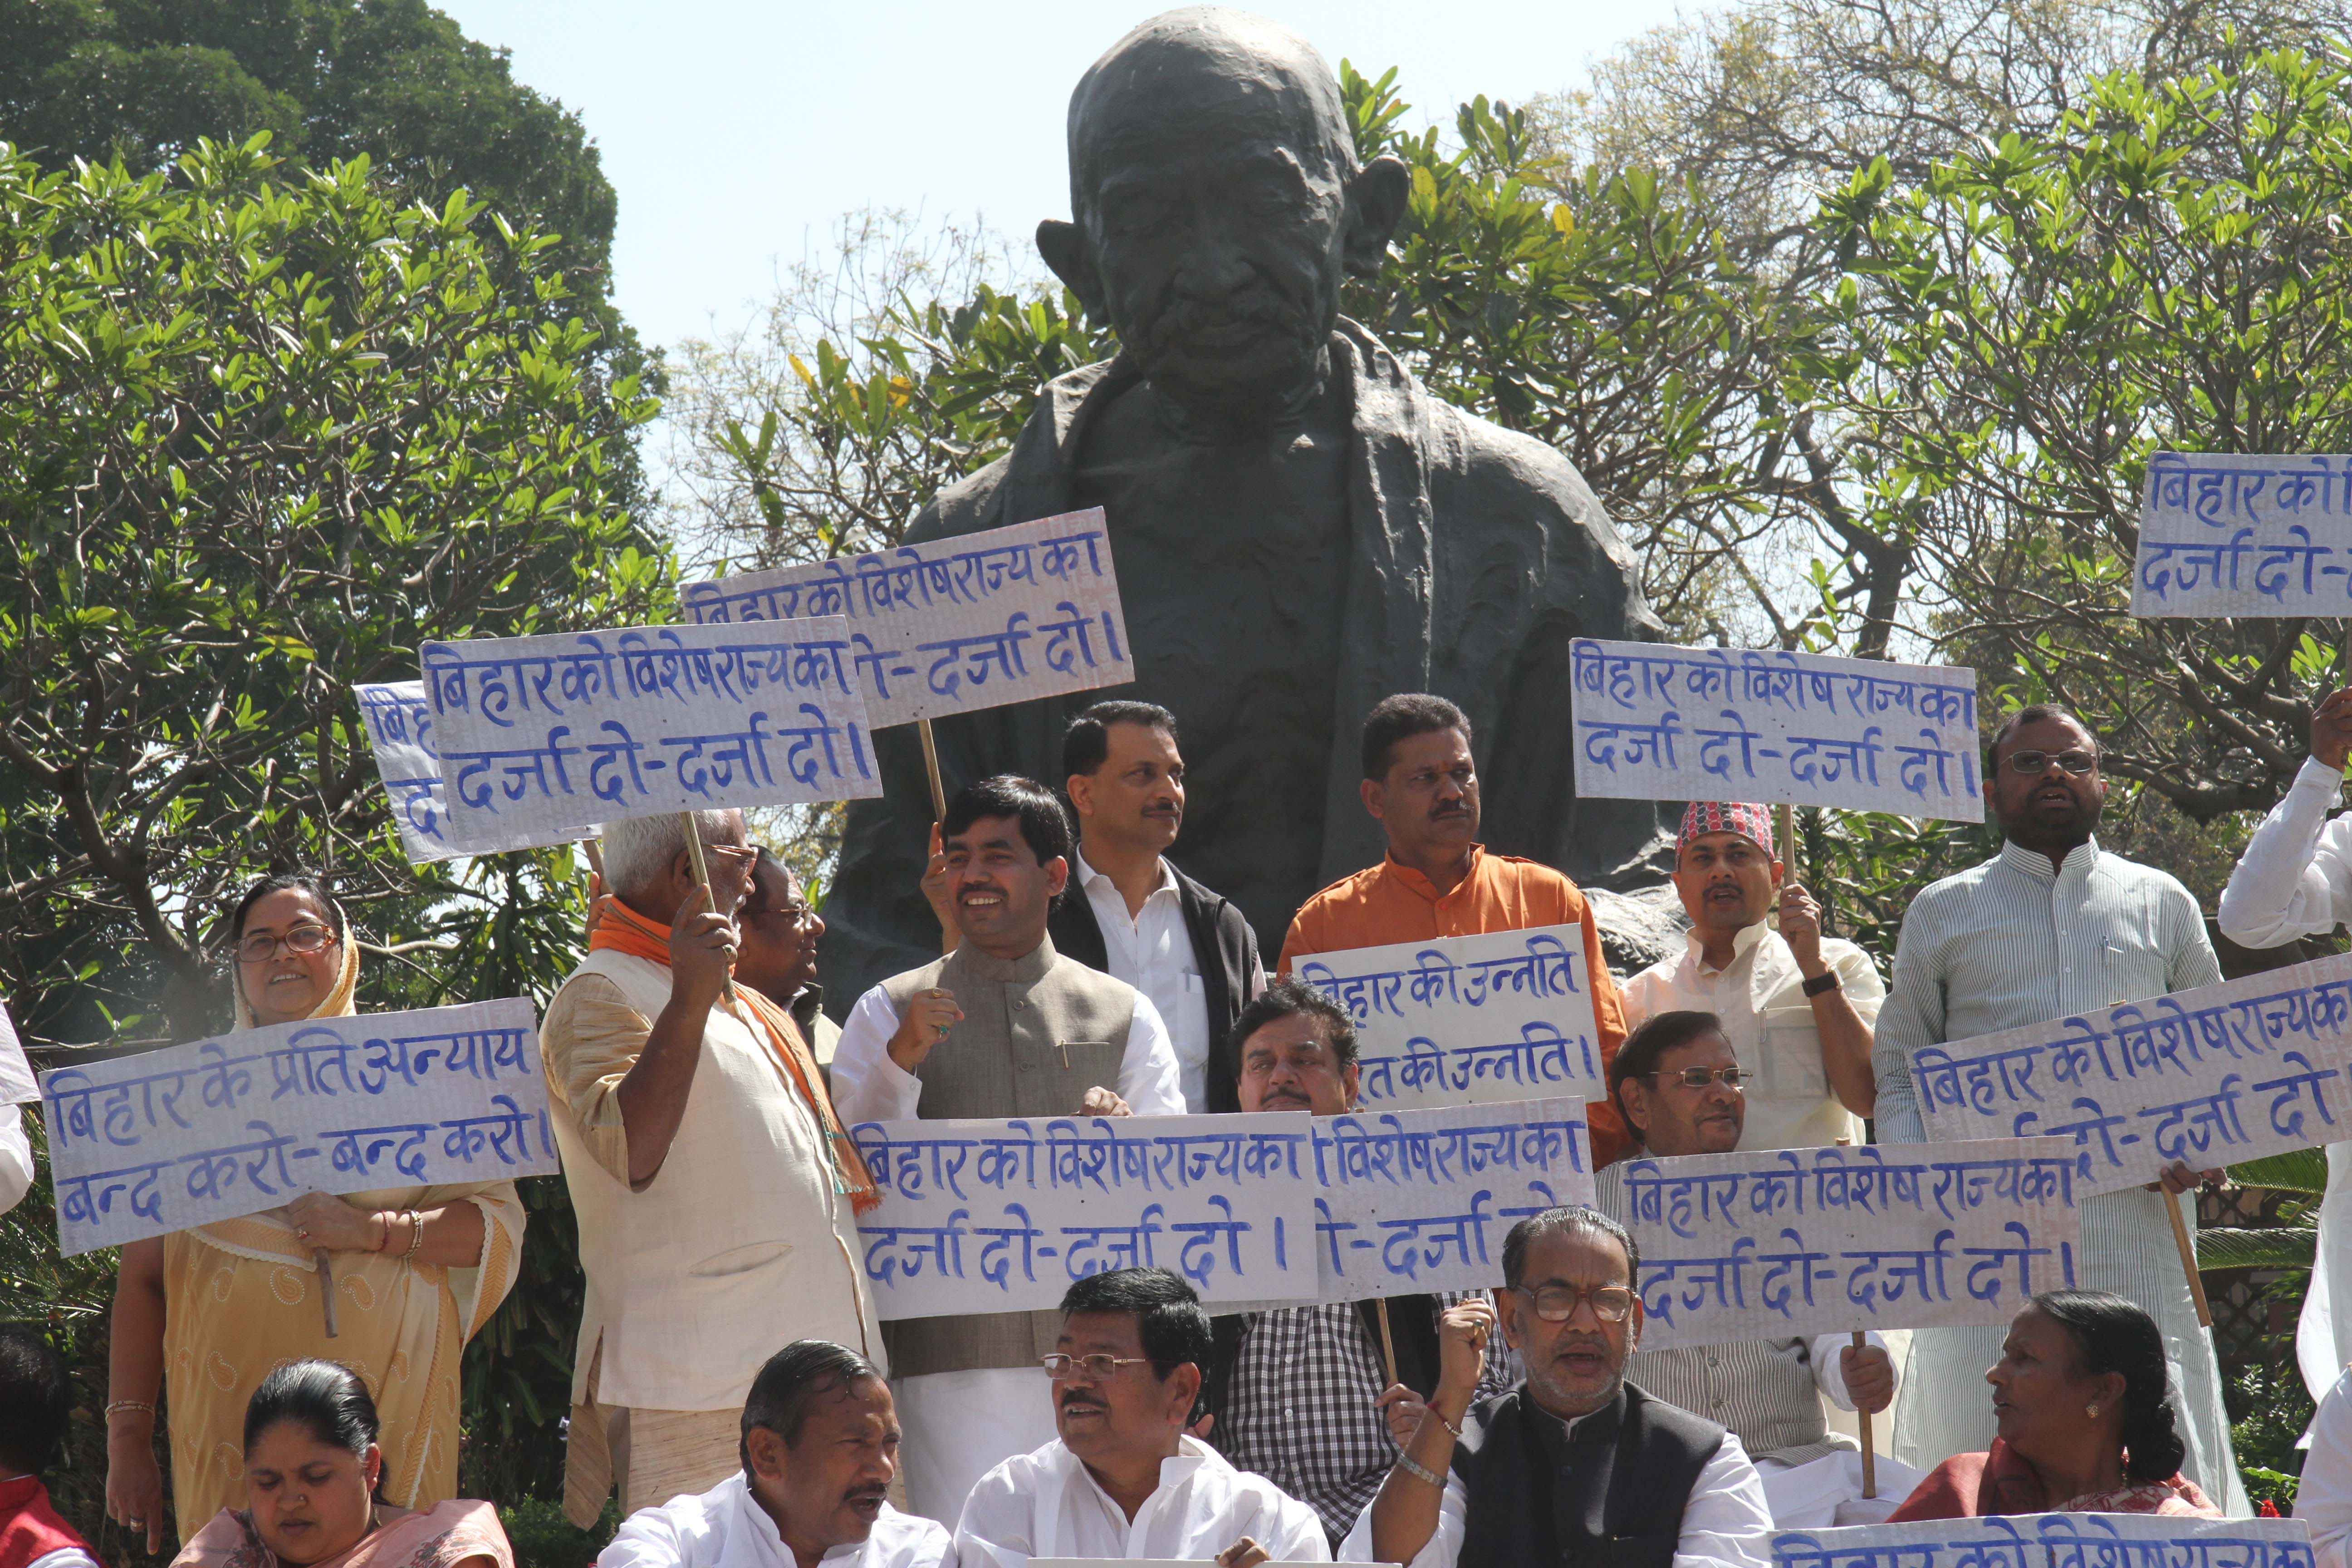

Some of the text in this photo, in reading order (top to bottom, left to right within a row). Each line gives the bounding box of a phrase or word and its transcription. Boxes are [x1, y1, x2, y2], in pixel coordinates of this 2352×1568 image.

[2149, 453, 2278, 528] बिहार
[2277, 456, 2341, 515] को
[805, 561, 857, 618] को
[857, 547, 960, 616] विशेष
[953, 545, 1038, 603] राज्य
[1039, 531, 1102, 582] का
[2141, 527, 2254, 602] दर्जा
[423, 629, 853, 727] बिहार को विशेष राज्य का
[1572, 640, 1977, 731] बिहार को विशेष राज्य का
[440, 726, 581, 814] दर्जा
[1578, 711, 1684, 772] दर्जा
[1406, 949, 1464, 1008] की
[1464, 935, 1579, 1006] उन्नति
[46, 1026, 531, 1147] बिहार के प्रति अन्याय
[1401, 1036, 1449, 1093] की
[1911, 1048, 2045, 1116] बिहार
[2047, 1017, 2119, 1087] को
[2111, 998, 2242, 1077] विशेष
[2229, 987, 2320, 1055] राज्य
[2252, 1051, 2352, 1141] दो
[852, 1122, 979, 1201] बिहार
[978, 1120, 1045, 1190] को
[1046, 1118, 1152, 1194] विशेष
[1153, 1133, 1247, 1191] राज्य
[1244, 1132, 1307, 1180] का
[1331, 1114, 1438, 1186] विशेष
[1436, 1124, 1525, 1183] राज्य
[1522, 1120, 1587, 1173] का
[1624, 1160, 1746, 1239] बिहार
[1748, 1151, 1809, 1216] को
[1811, 1146, 1929, 1216] विशेष
[1931, 1158, 2026, 1221] राज्य
[2021, 1157, 2077, 1208] का
[56, 1161, 175, 1225] बन्द
[858, 1208, 970, 1290] दर्जा
[1639, 1237, 1756, 1329] दर्जा
